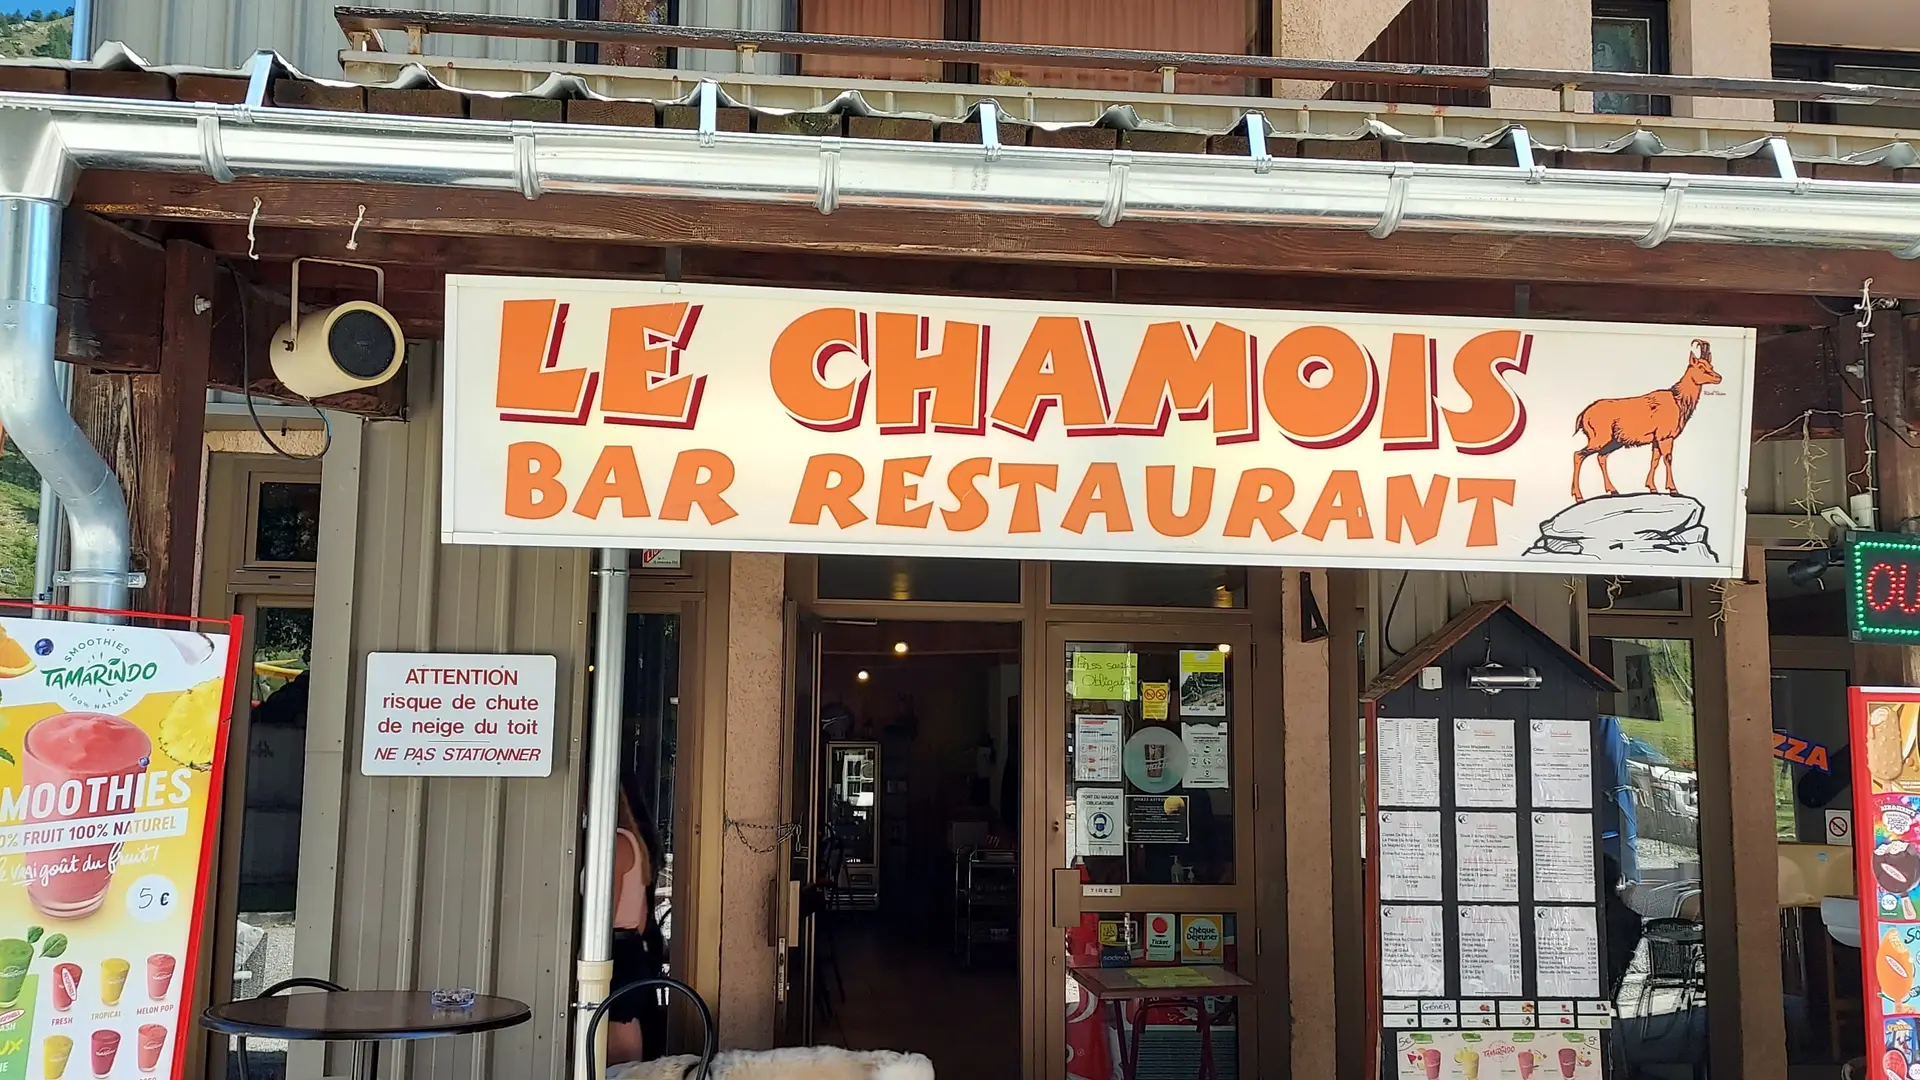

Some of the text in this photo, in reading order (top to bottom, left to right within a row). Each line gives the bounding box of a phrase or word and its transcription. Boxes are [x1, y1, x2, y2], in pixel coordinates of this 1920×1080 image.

[496, 299, 1534, 455] LE CHAMOIS
[504, 441, 1517, 547] BAR RESTAURANT
[1866, 562, 1920, 613] OU
[64, 637, 130, 663] SMOOTHIES
[39, 660, 158, 690] TAMARINDO
[405, 668, 518, 686] ATTENTION
[94, 687, 133, 710] NATUREL
[382, 692, 539, 712] risque de chute
[377, 717, 538, 737] de neige du toit
[374, 747, 541, 762] NE PAS STATIONNER
[1773, 732, 1829, 772] ZZA
[0, 767, 192, 821] MOOTHIES
[23, 827, 65, 845] FRUIT
[68, 823, 108, 841] 100%
[113, 816, 176, 835] NATUREL
[39, 854, 81, 887] goût
[82, 852, 107, 873] du
[1186, 932, 1218, 942] Déjeuner
[1188, 926, 1216, 935] Chèque
[1150, 938, 1169, 946] Ticket
[91, 1010, 121, 1020] TROPICAL
[136, 1004, 174, 1016] MELON POP
[51, 1017, 73, 1027] FRESH
